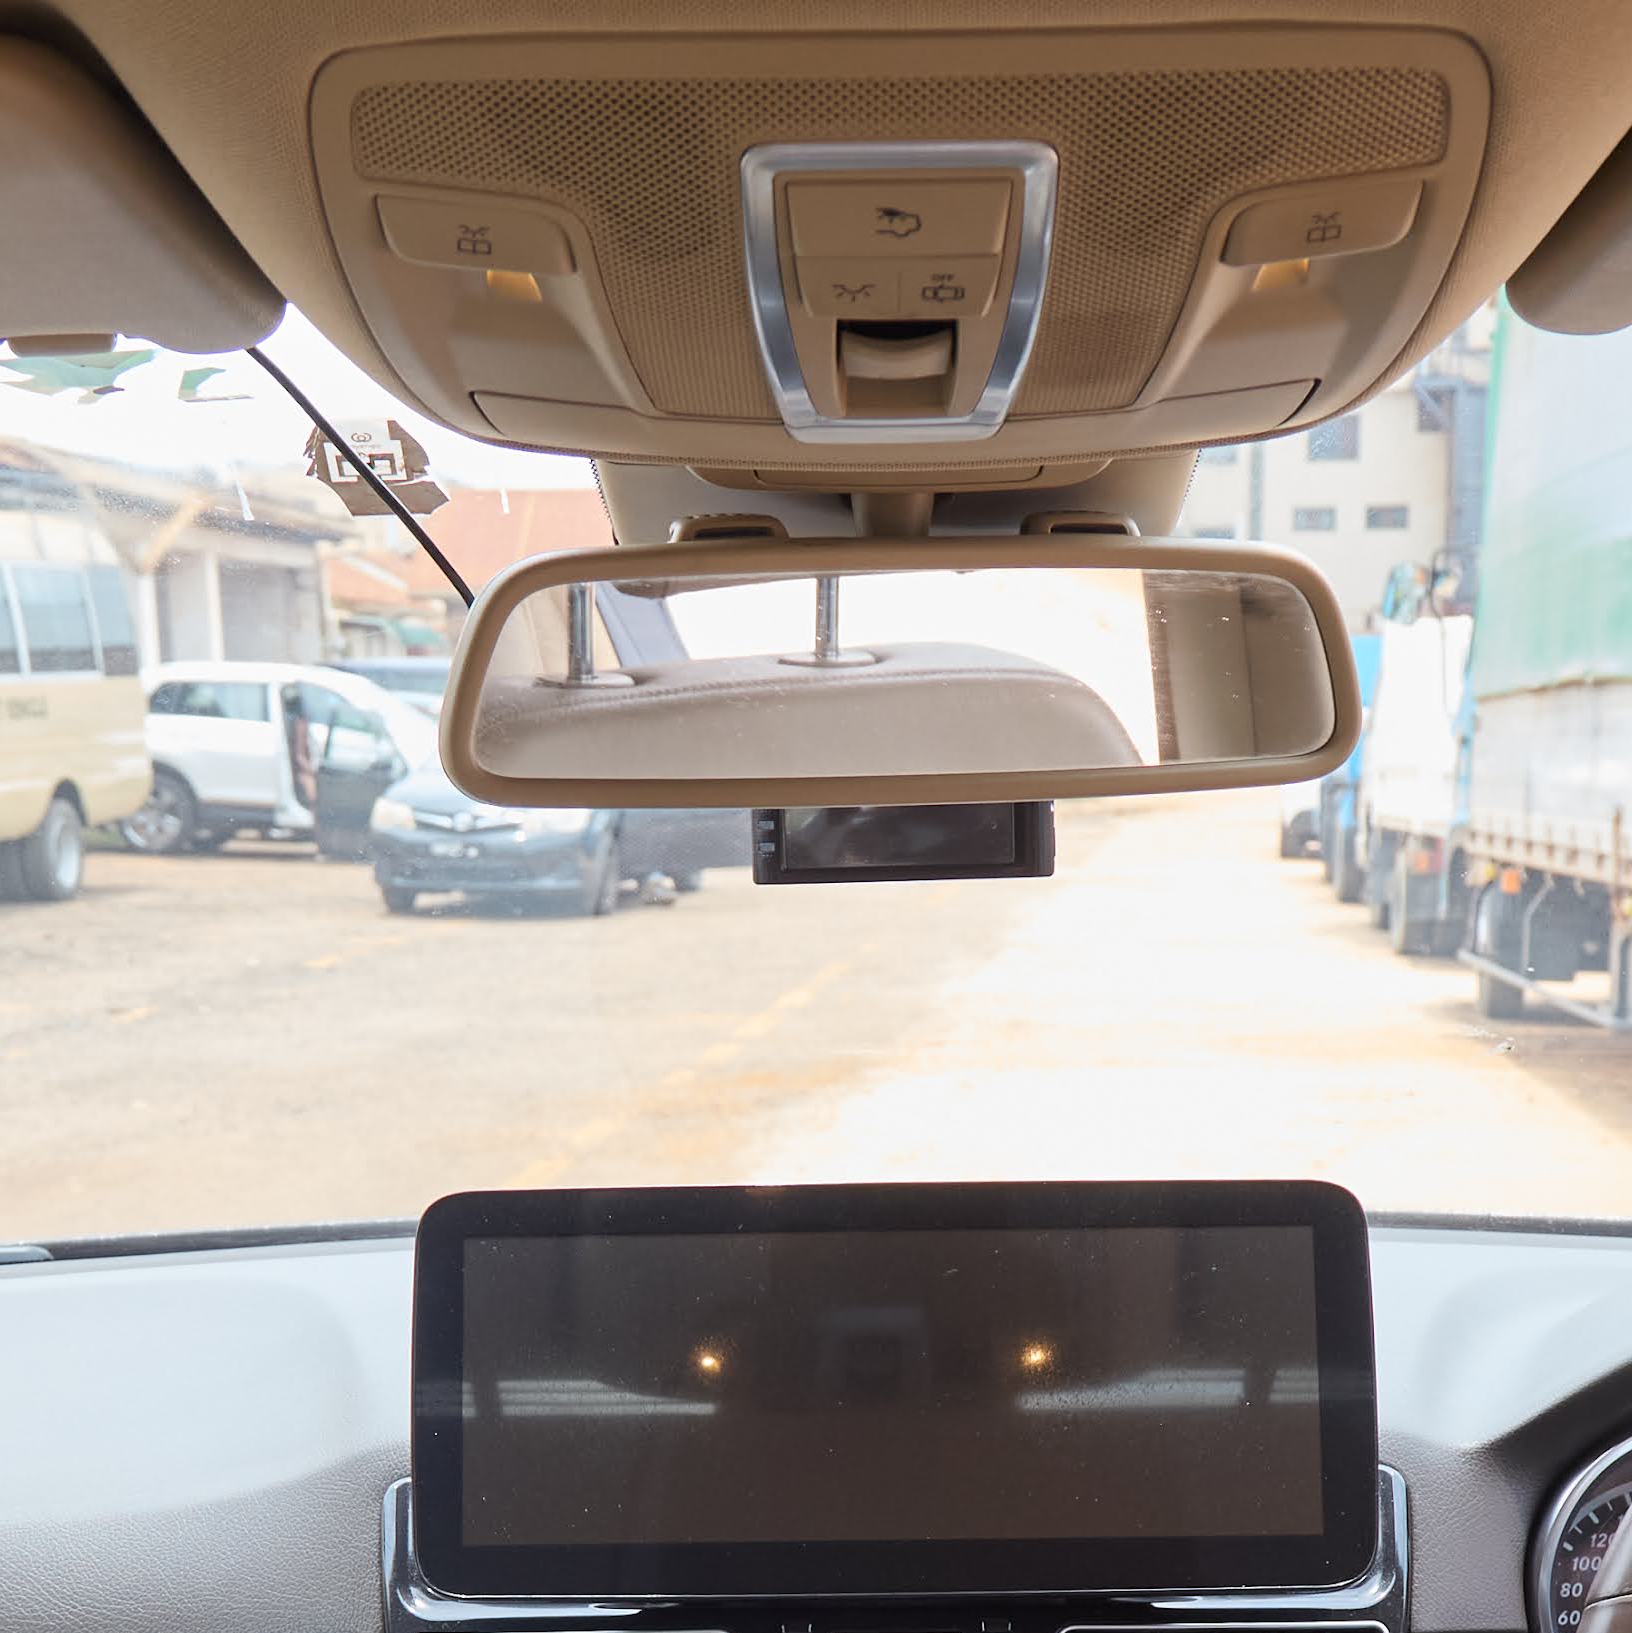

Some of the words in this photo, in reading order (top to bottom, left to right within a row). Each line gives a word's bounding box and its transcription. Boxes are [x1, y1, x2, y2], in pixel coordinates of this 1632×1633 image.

[1571, 1556, 1602, 1571] 100
[1559, 1582, 1583, 1598] 80
[1557, 1610, 1581, 1626] 60
